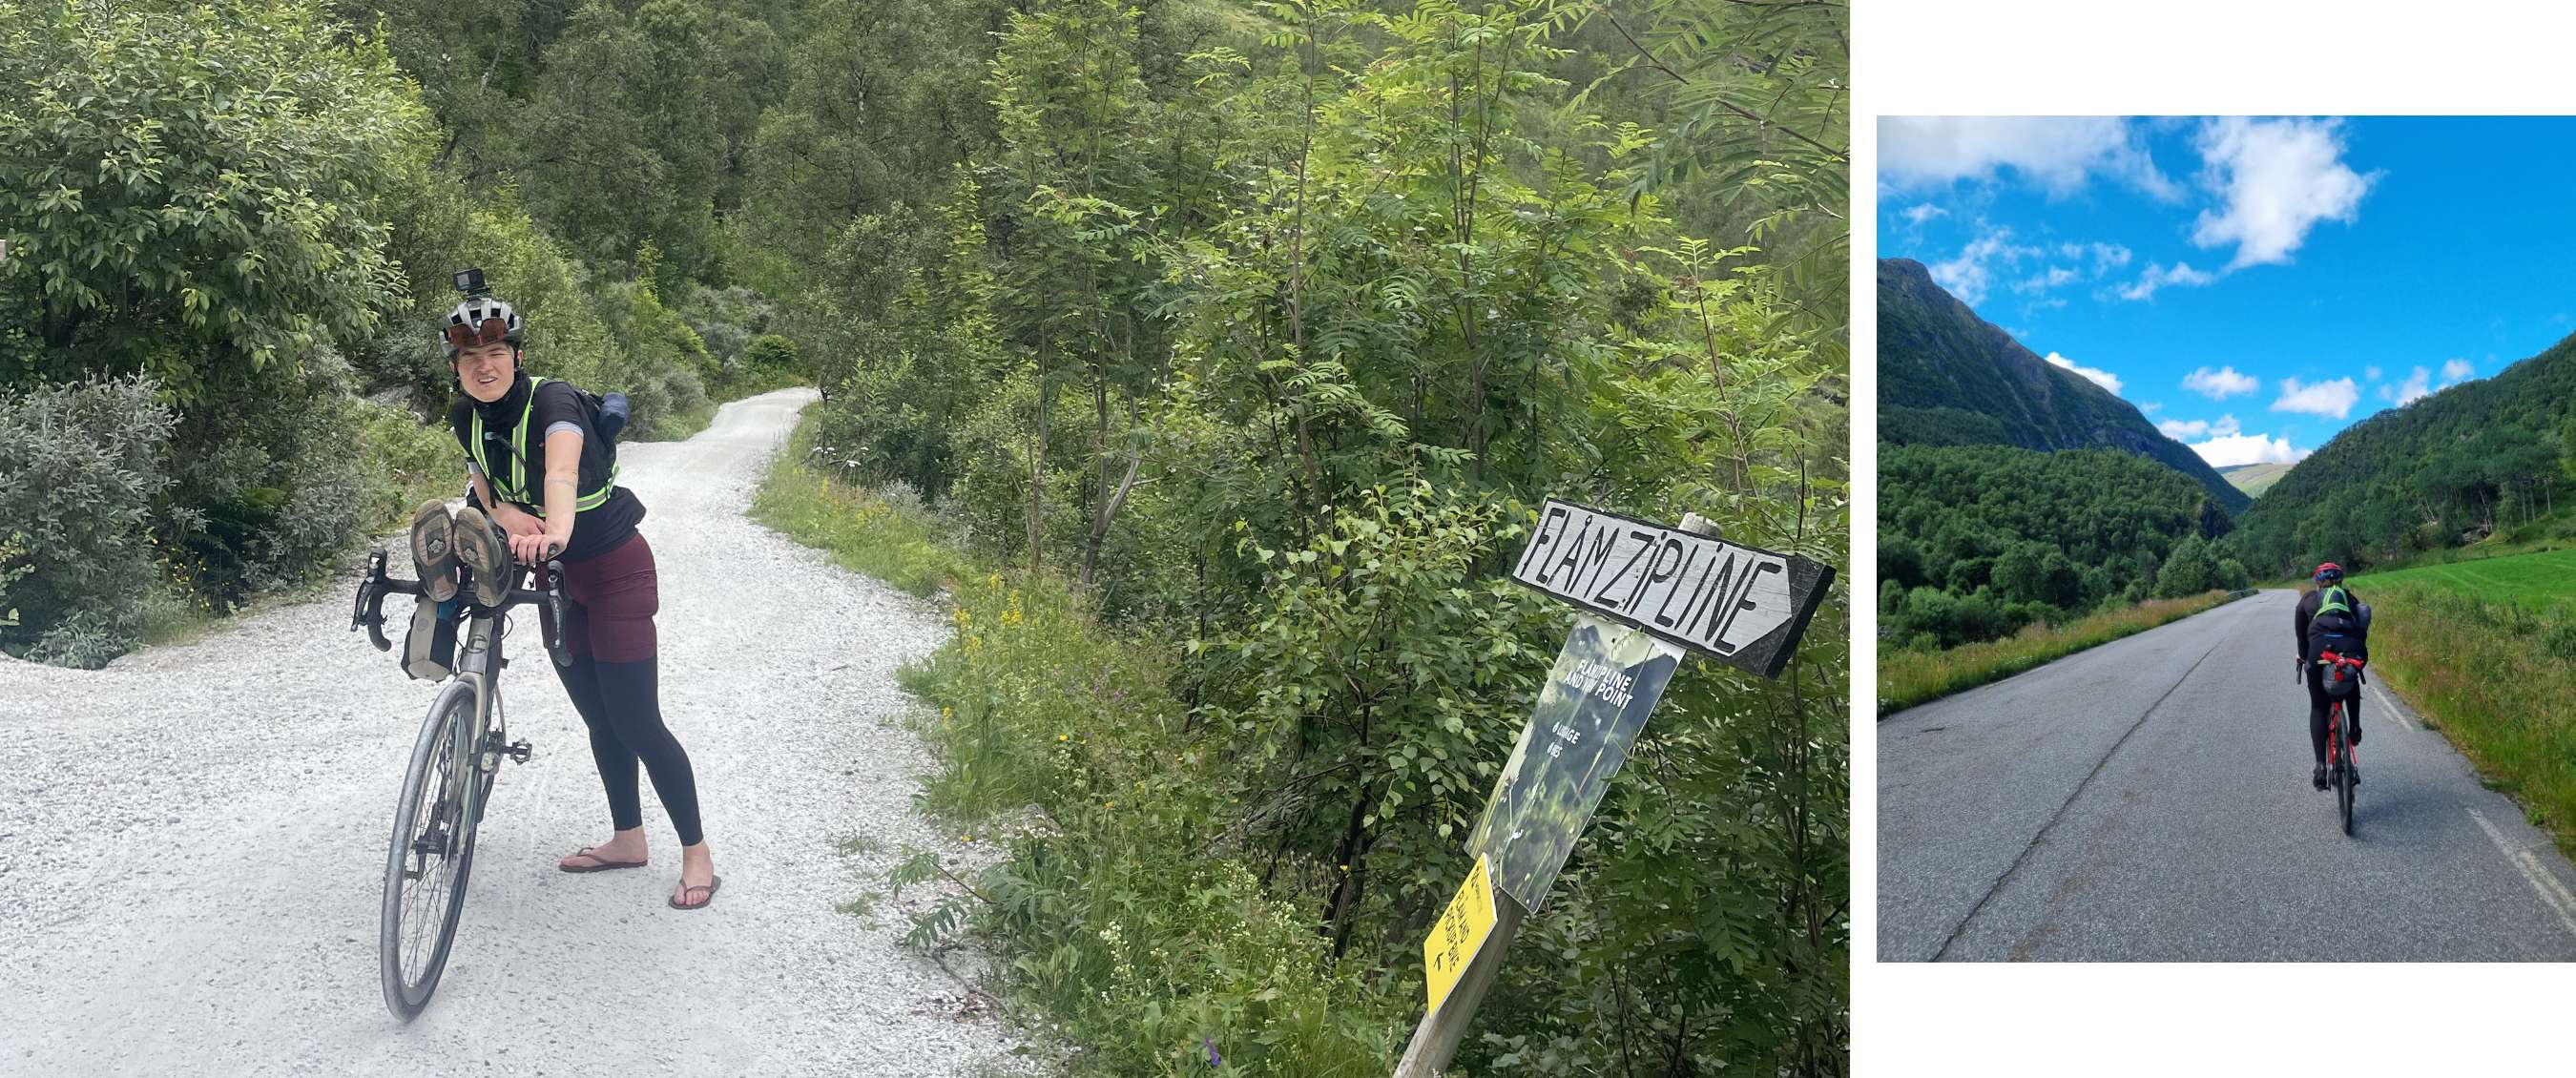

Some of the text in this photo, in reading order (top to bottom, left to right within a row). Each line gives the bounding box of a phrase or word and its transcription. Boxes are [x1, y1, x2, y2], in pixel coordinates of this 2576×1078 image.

[1519, 508, 1782, 654] FLÅM ZIPLINE
[1565, 671, 1584, 688] AND
[1594, 682, 1633, 710] POINT
